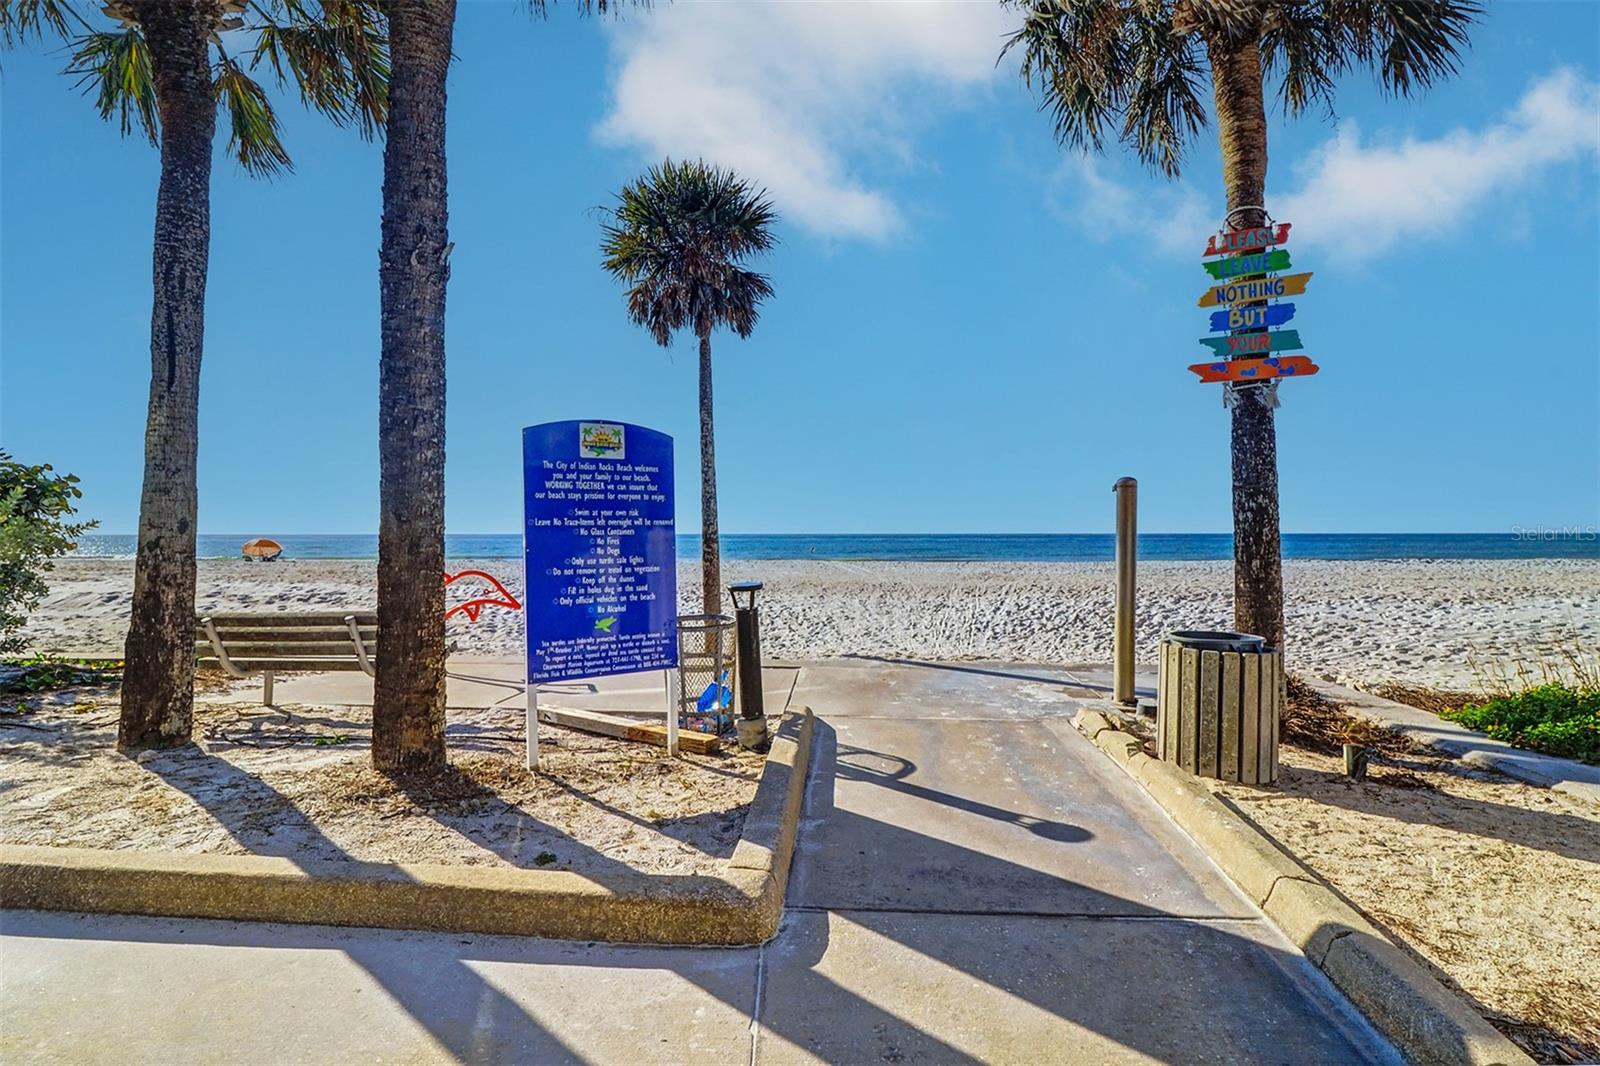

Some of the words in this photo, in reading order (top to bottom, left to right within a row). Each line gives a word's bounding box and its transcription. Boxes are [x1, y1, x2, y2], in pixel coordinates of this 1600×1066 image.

[1217, 227, 1277, 250] LEASE
[1220, 253, 1272, 276] LEAVE
[1216, 279, 1285, 303] NOTHING
[1228, 308, 1268, 328] BUT
[1227, 332, 1271, 352] YOUR
[543, 460, 554, 469] The
[556, 461, 568, 472] City
[570, 461, 576, 470] of
[578, 461, 597, 470] Indian
[599, 462, 614, 471] Rocks
[616, 463, 633, 472] Beach
[634, 464, 659, 473] welcomes
[552, 473, 564, 481] you
[566, 471, 577, 480] and
[580, 473, 592, 482] your
[595, 472, 612, 483] family
[544, 480, 574, 490] WORKING
[575, 481, 605, 490] TOGETHER
[646, 483, 658, 492] that
[547, 490, 566, 500] beach
[567, 492, 582, 502] stays
[584, 491, 605, 502] pristine
[607, 492, 616, 500] for
[617, 493, 641, 503] everyone
[574, 508, 590, 517] Swim
[600, 510, 614, 519] your
[628, 508, 640, 517] risk
[534, 517, 551, 527] Leave
[553, 517, 562, 527] No
[596, 517, 606, 527] left
[607, 517, 632, 529] overnight
[633, 517, 644, 527] will
[644, 517, 652, 527] be
[580, 527, 589, 536] No
[590, 527, 605, 537] Glass
[607, 527, 635, 537] Containers
[596, 537, 605, 546] No
[607, 536, 620, 546] Fires
[596, 547, 605, 556] No
[607, 546, 620, 557] Dogs
[571, 556, 585, 568] Only
[552, 567, 562, 576] Do
[563, 568, 574, 576] not
[582, 576, 596, 587] Keep
[597, 575, 606, 584] off
[607, 575, 617, 583] the
[619, 574, 636, 583] dunes
[578, 586, 586, 594] in
[587, 585, 602, 594] holes
[603, 586, 615, 595] dug
[616, 584, 623, 592] in
[624, 584, 634, 592] the
[635, 583, 649, 592] sand
[559, 597, 573, 607] Only
[575, 595, 594, 604] official
[596, 595, 618, 603] vehicles
[629, 593, 638, 601] the
[639, 592, 656, 601] beach
[597, 605, 606, 613] No
[607, 604, 627, 613] Alcohol
[561, 669, 566, 677] &
